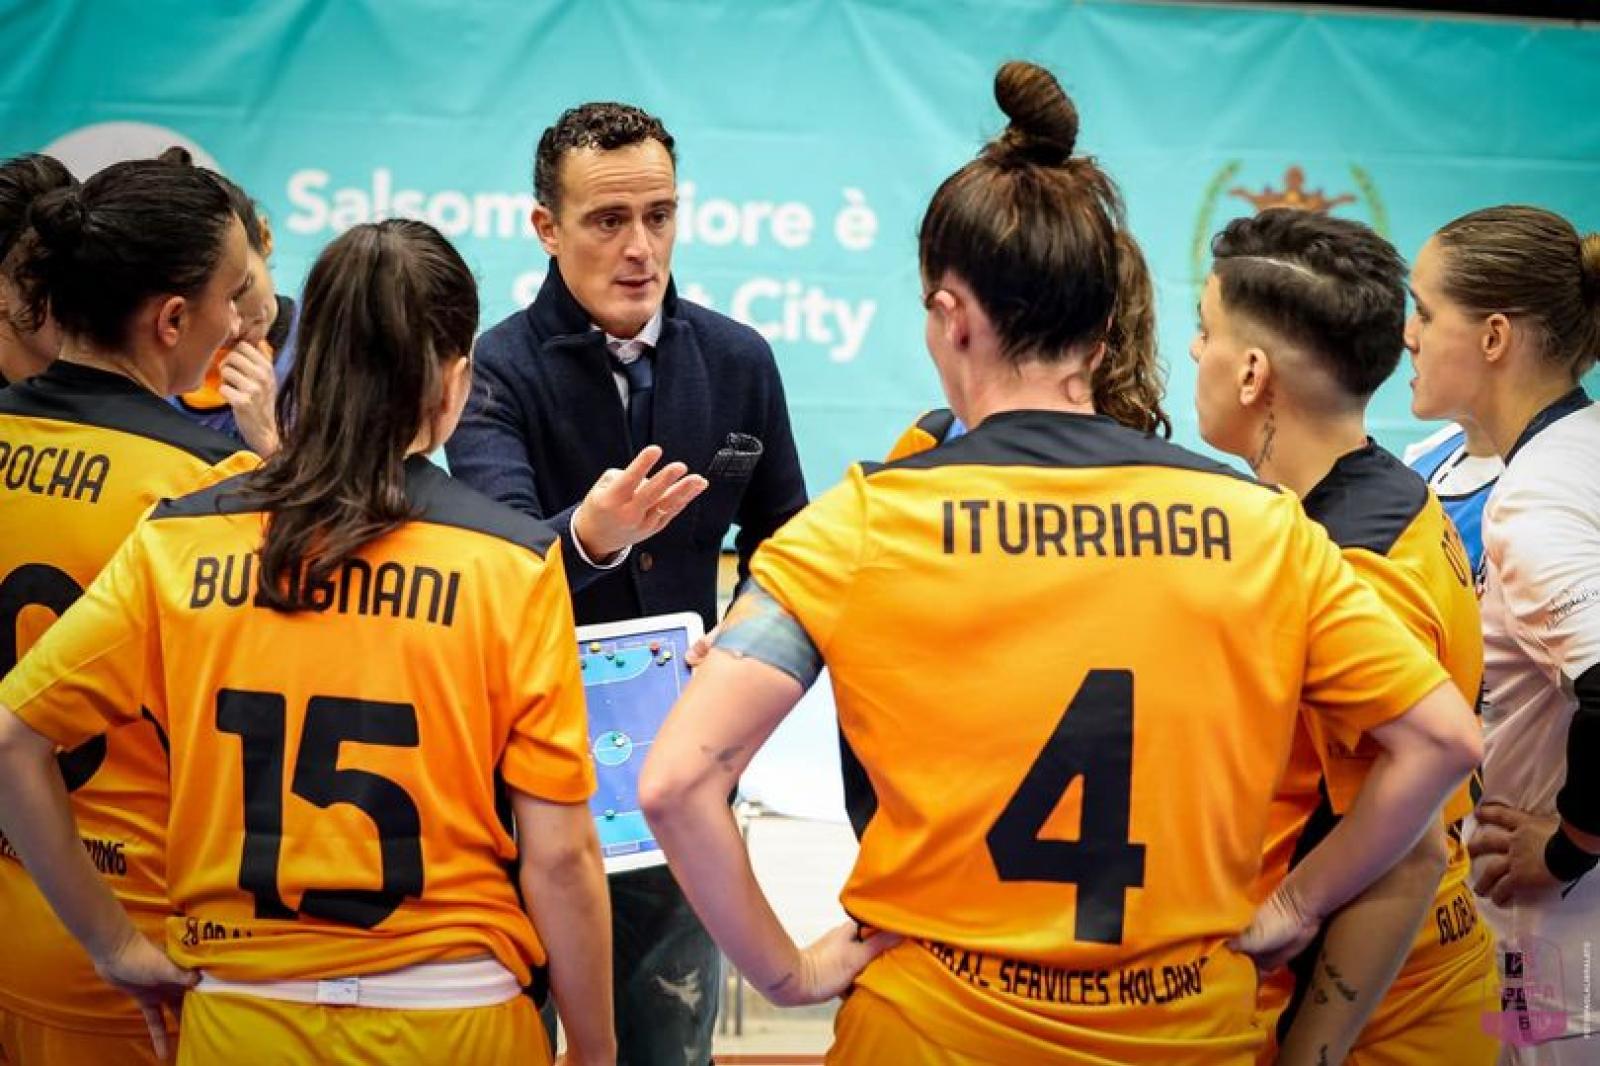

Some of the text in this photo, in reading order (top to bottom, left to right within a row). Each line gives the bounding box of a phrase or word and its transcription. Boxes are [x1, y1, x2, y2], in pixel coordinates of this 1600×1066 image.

[834, 186, 877, 250] è
[732, 277, 876, 363] City
[942, 499, 1232, 562] ITURRIAGA
[216, 688, 424, 929] 15
[985, 669, 1146, 945] 4
